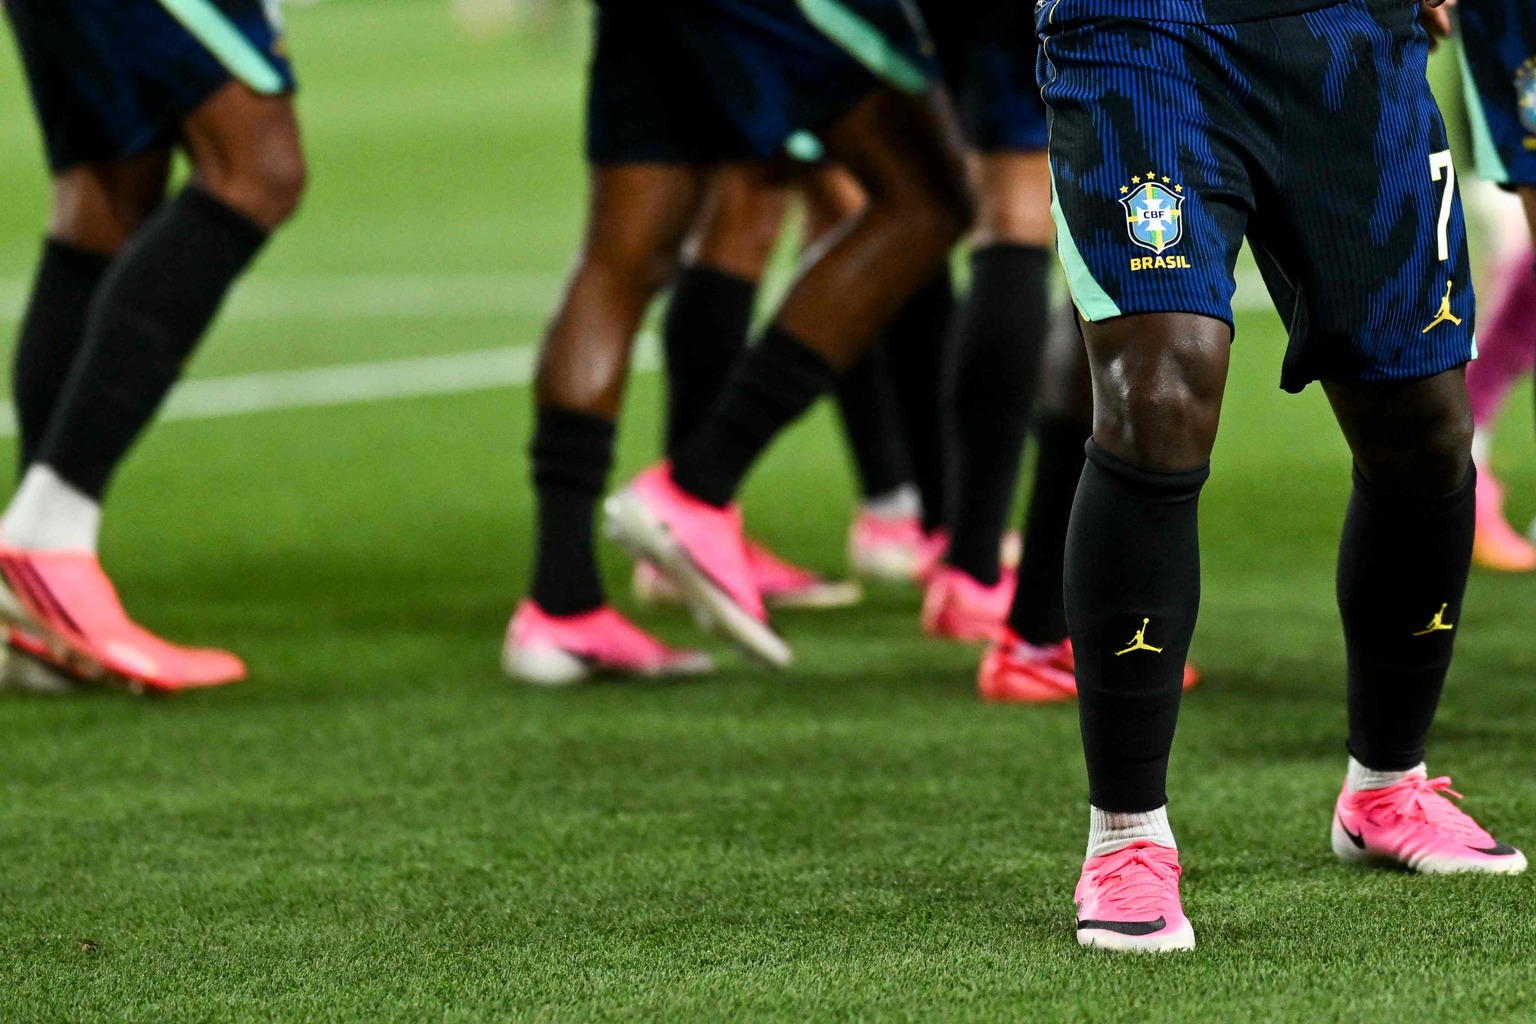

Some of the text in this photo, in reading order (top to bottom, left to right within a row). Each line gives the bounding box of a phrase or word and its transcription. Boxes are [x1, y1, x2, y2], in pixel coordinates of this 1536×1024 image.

[1429, 149, 1455, 261] 7
[1143, 210, 1165, 219] CBF
[1130, 255, 1191, 271] BRASIL
